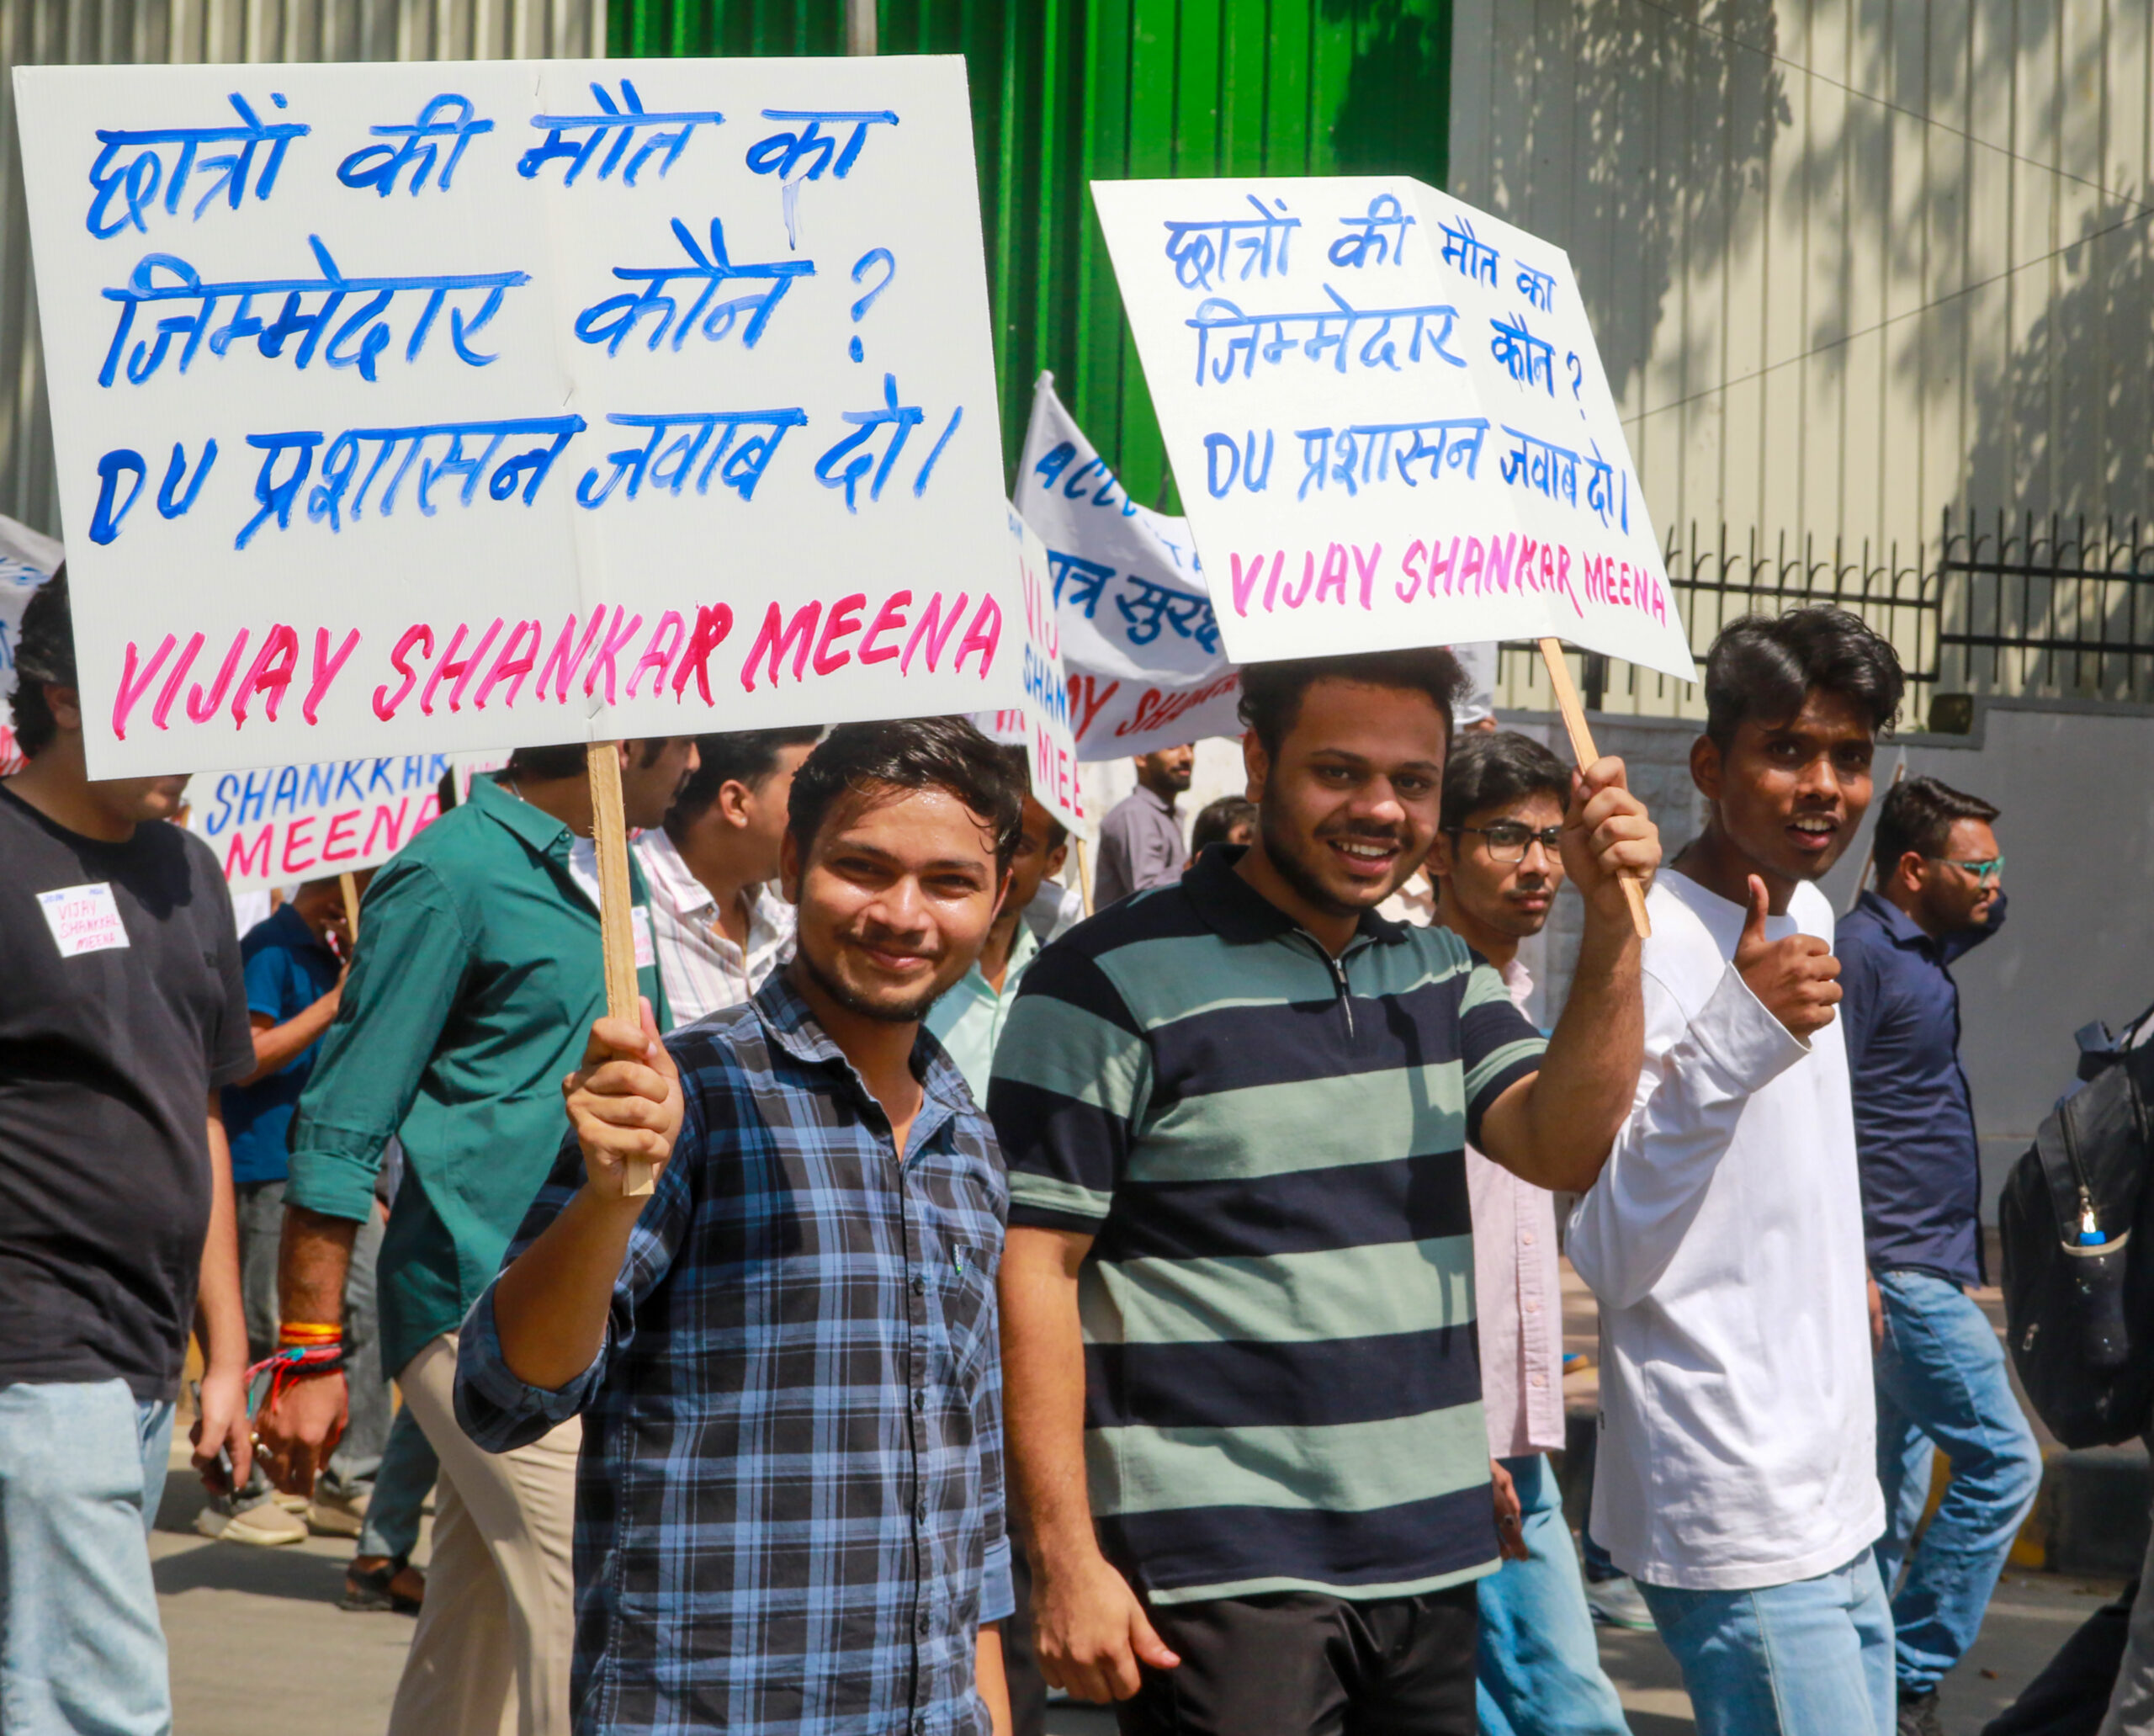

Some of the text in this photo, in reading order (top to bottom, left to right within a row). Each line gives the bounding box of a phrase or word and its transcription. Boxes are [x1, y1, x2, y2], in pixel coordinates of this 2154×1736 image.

[87, 78, 900, 239] छात्रों की मौत का
[98, 234, 533, 388] जिम्मेदार
[575, 216, 816, 358] कौन
[1165, 194, 1557, 314] छात्रों की मौत का
[1185, 284, 1468, 386] जिम्मेदार
[1489, 311, 1556, 399] कौन
[89, 438, 218, 545] DU
[234, 414, 588, 550] प्रशासन
[576, 406, 809, 510] जवाब
[1204, 429, 1274, 499] DU
[1295, 418, 1490, 502] प्रशासन
[1500, 423, 1581, 509] जवाब
[1229, 532, 1666, 629] VIJAY SHANKAR MEENA
[112, 627, 363, 741] VIJAY
[373, 603, 735, 724] SHANKAR
[740, 589, 1002, 693] MEENA
